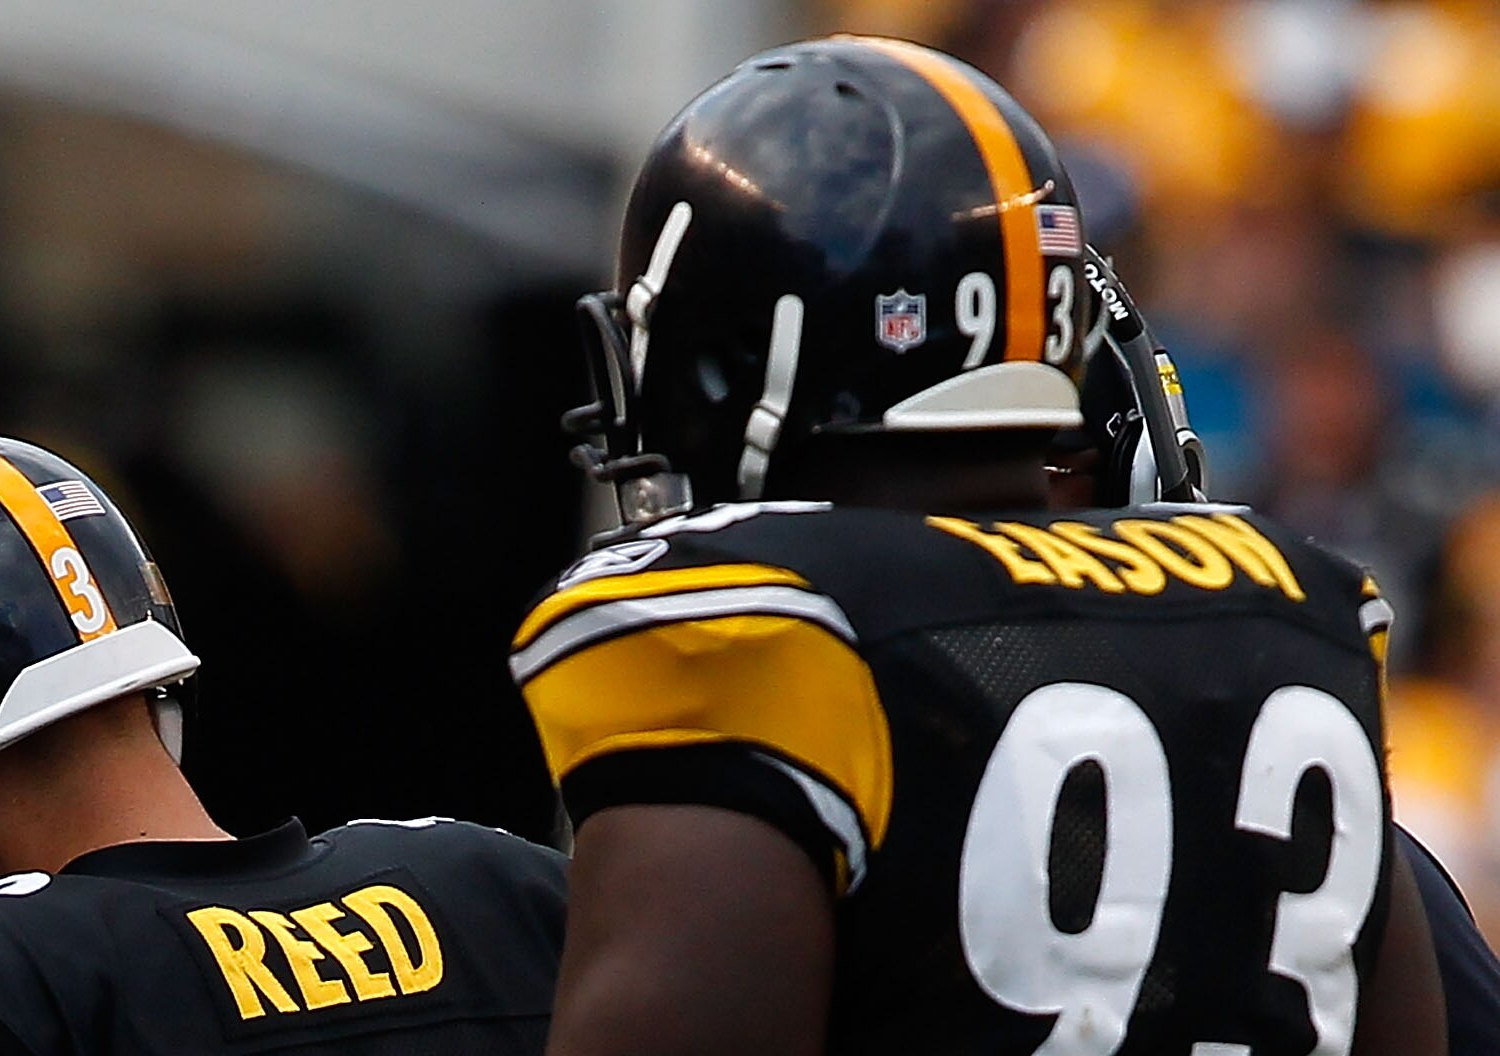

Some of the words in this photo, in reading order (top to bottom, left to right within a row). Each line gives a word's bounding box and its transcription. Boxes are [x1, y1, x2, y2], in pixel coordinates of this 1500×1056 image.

[49, 546, 107, 634] 3
[925, 514, 1306, 602] EASON
[184, 884, 445, 1021] REED
